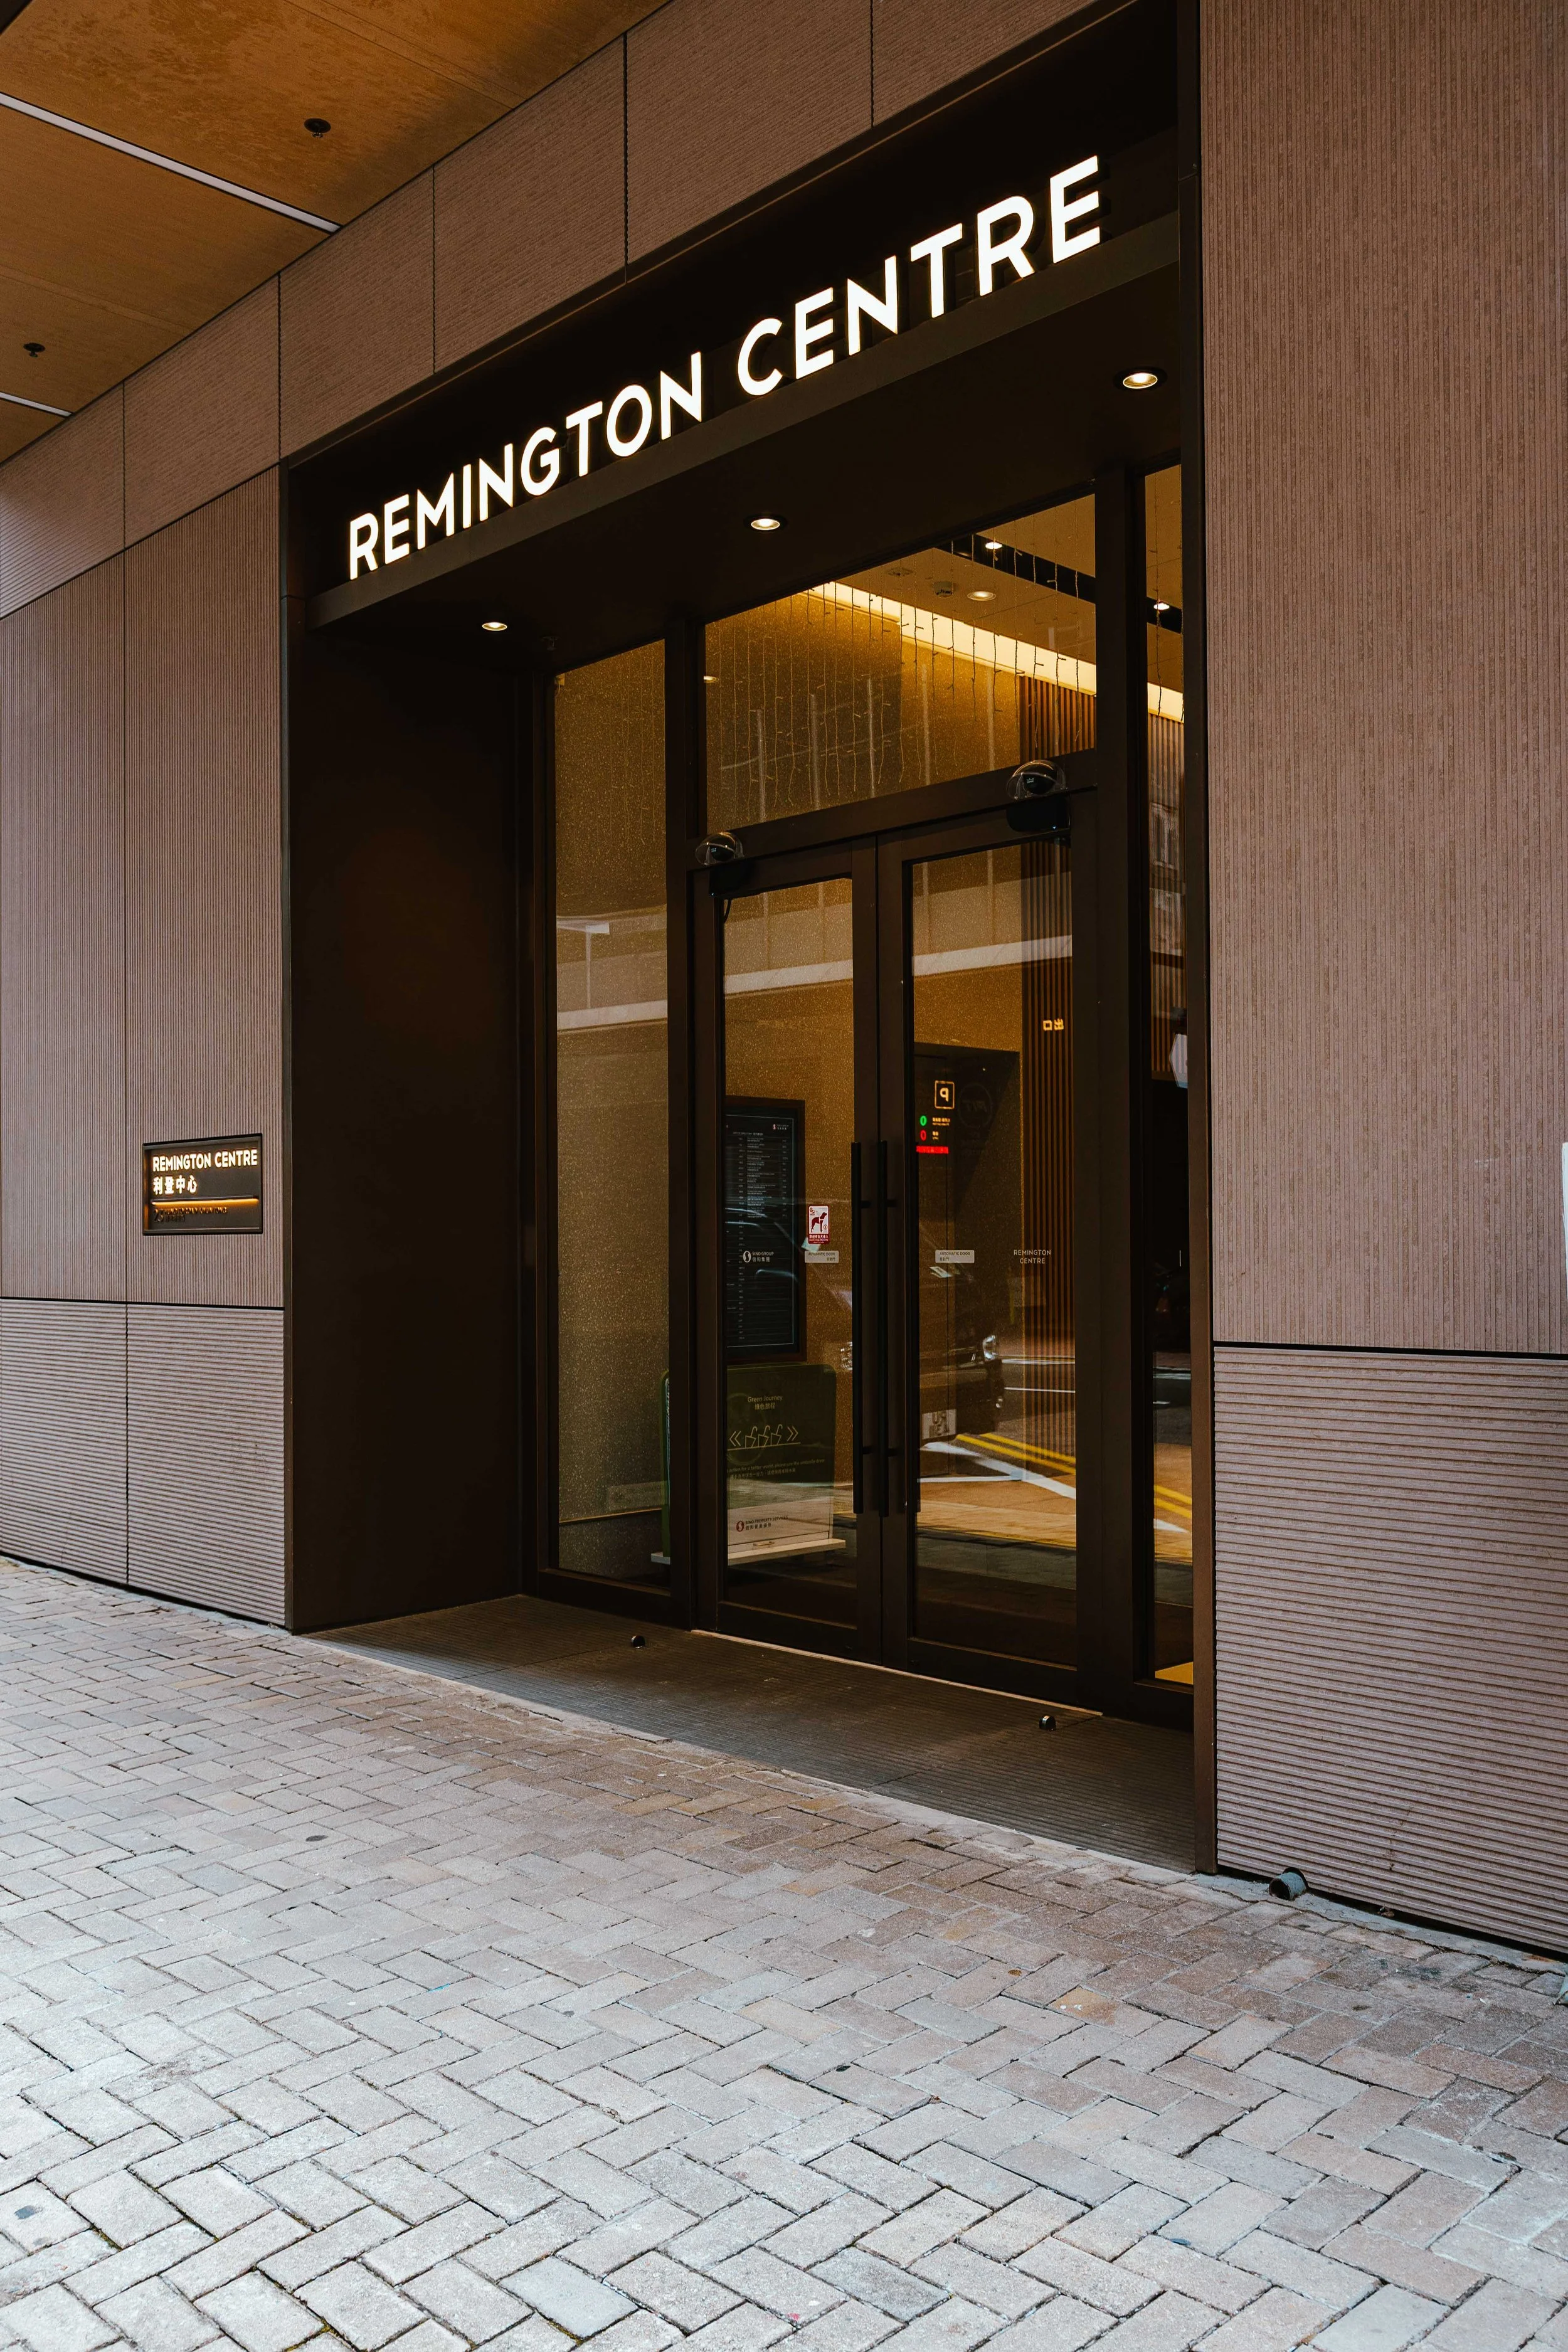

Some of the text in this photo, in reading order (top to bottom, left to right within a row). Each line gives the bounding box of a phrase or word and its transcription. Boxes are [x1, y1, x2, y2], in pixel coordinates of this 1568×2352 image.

[349, 155, 1101, 580] REMINGTON CENTRE
[152, 1148, 258, 1172] REMINGTON CENTRE
[152, 1174, 198, 1195] 利登中心
